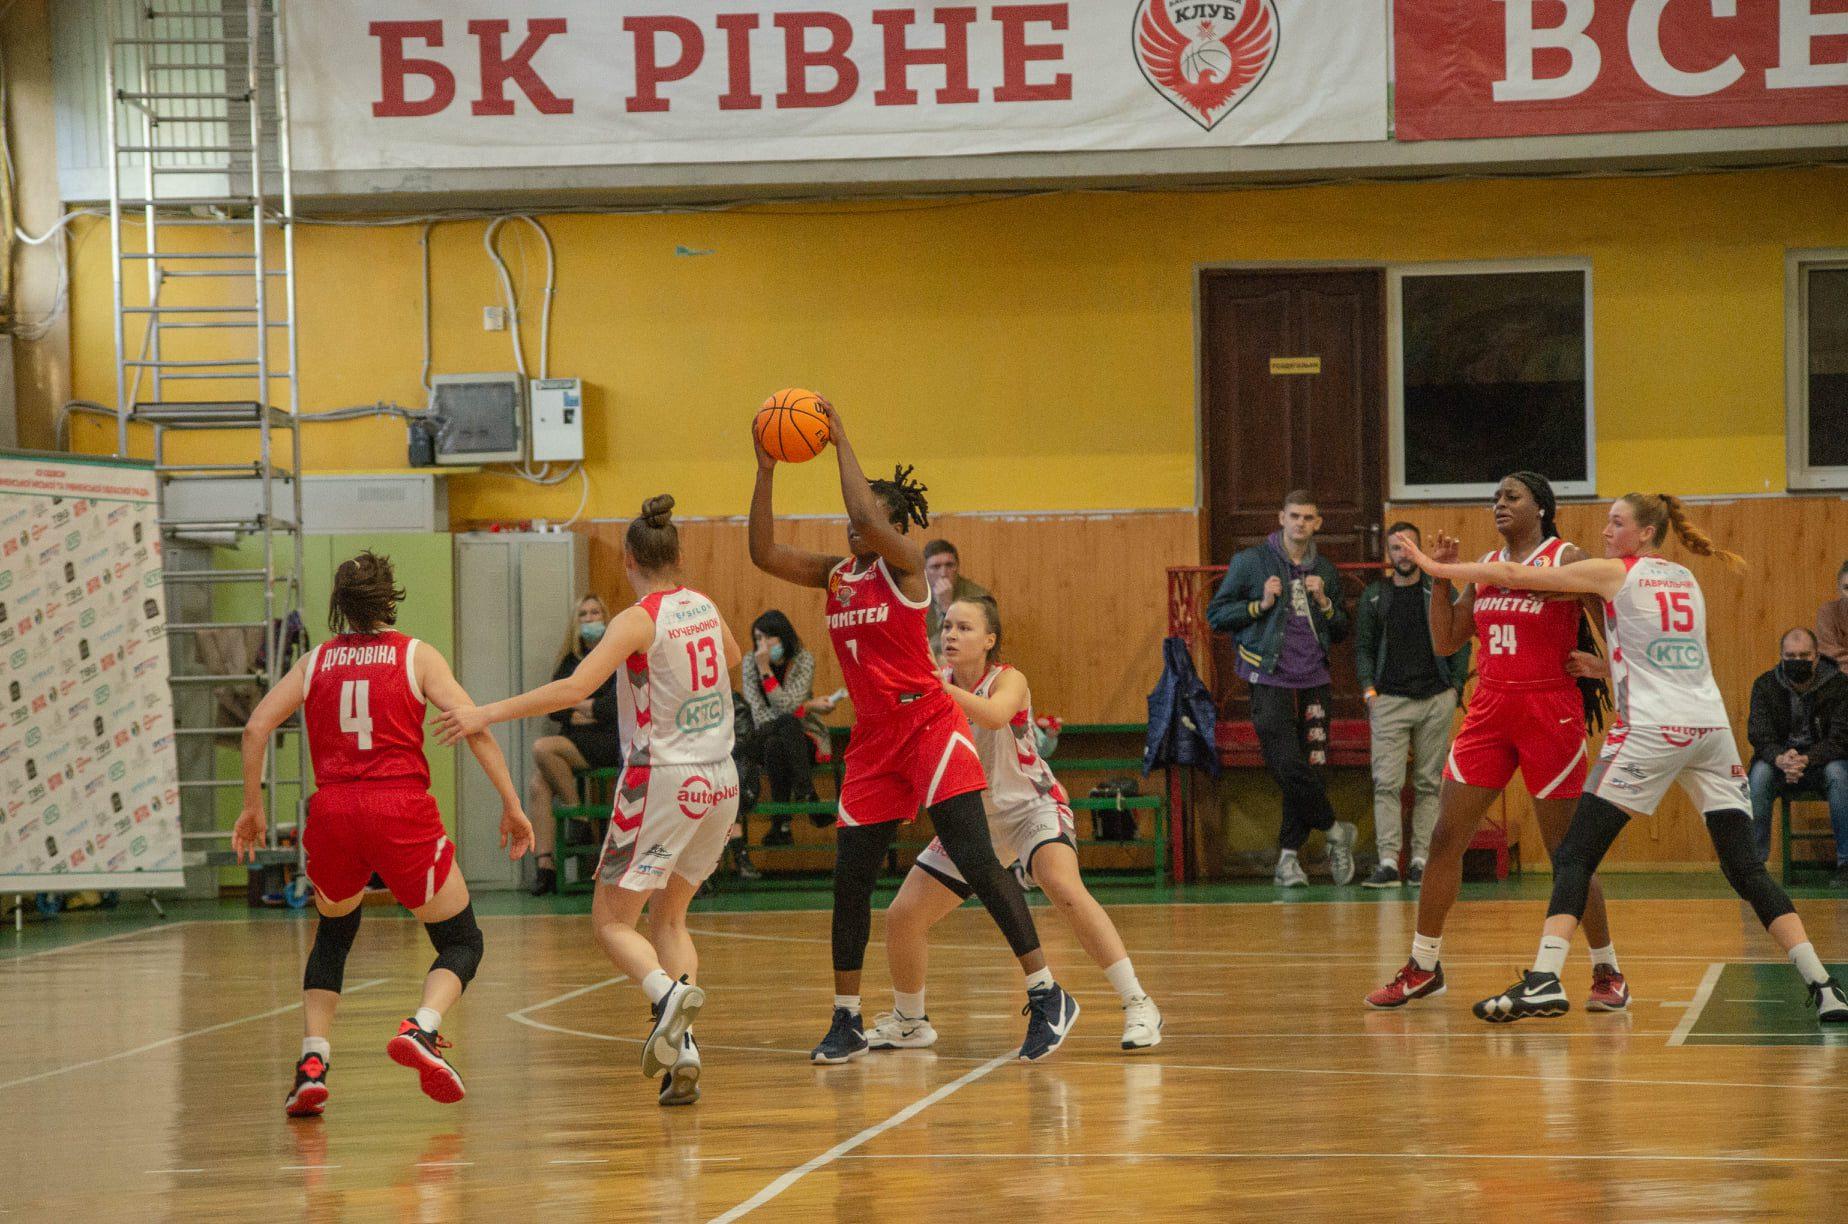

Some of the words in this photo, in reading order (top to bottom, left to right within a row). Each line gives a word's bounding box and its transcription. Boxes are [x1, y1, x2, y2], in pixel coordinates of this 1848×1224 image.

[1175, 4, 1236, 23] КЛУБ
[368, 17, 575, 118] БК
[622, 2, 1073, 113] РІВНЕ
[825, 603, 890, 629] РОМЕТЕЙ
[1656, 592, 1695, 632] 15
[1489, 624, 1517, 655] 24
[321, 645, 397, 673] ДУБРОВІНА
[686, 636, 719, 692] 13
[340, 680, 373, 750] 4
